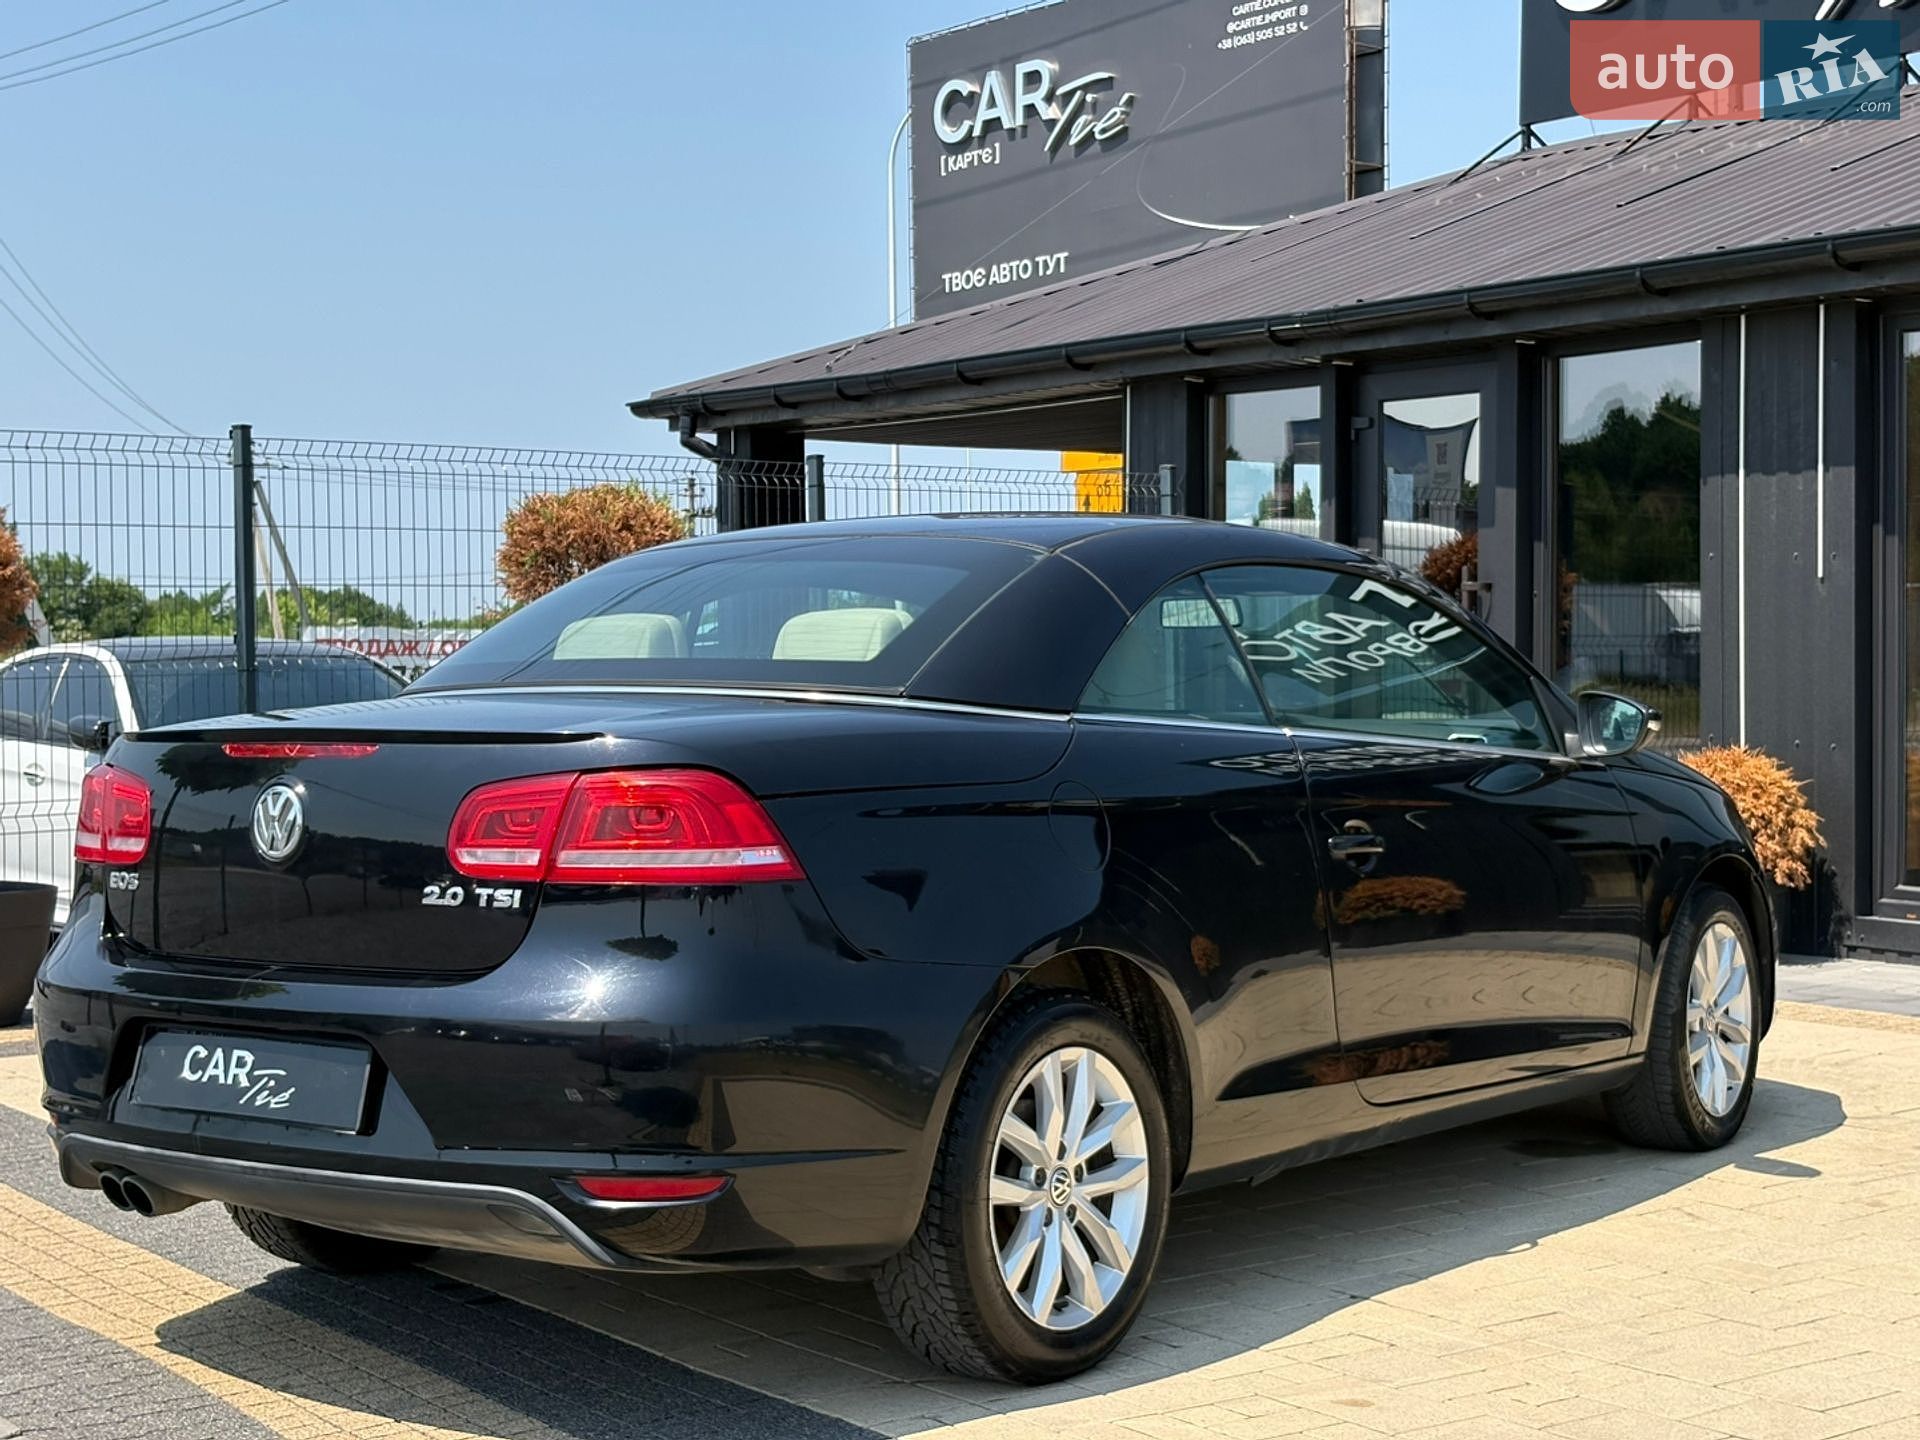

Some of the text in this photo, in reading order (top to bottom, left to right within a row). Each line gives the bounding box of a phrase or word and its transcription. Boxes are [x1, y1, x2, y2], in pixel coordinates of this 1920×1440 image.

[1217, 22, 1298, 50] +38 (063) 505 52 52
[933, 59, 1060, 144] CAR
[942, 251, 1069, 293] ТВОЄ АВТО ТУТ
[109, 871, 140, 891] EOS
[421, 885, 523, 908] 2.0 TSI
[179, 1044, 256, 1088] CAR
